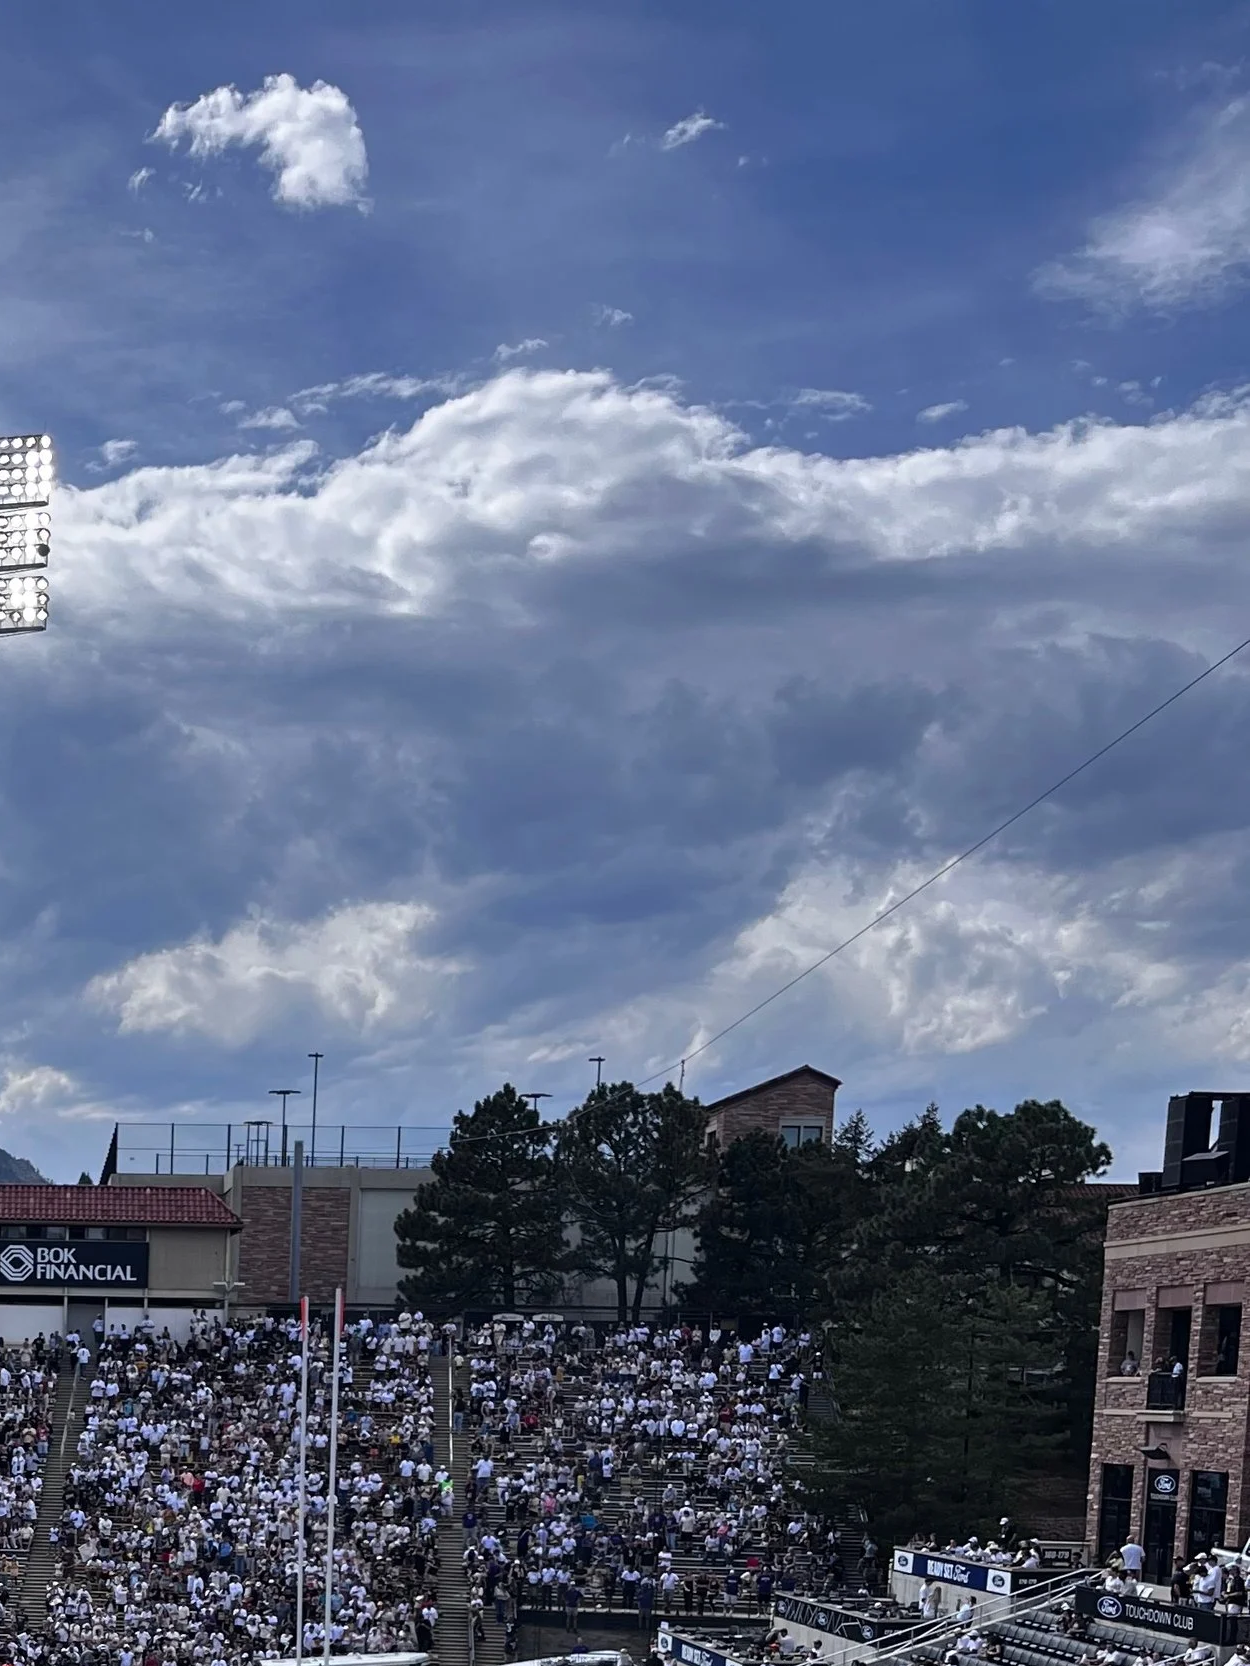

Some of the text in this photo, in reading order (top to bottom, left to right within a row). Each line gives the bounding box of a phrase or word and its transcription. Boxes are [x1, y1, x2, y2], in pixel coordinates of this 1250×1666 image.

[36, 1248, 77, 1264] BOK
[36, 1265, 137, 1281] FINANCIAL
[1125, 1604, 1194, 1631] TOUCHDOWN CLUB
